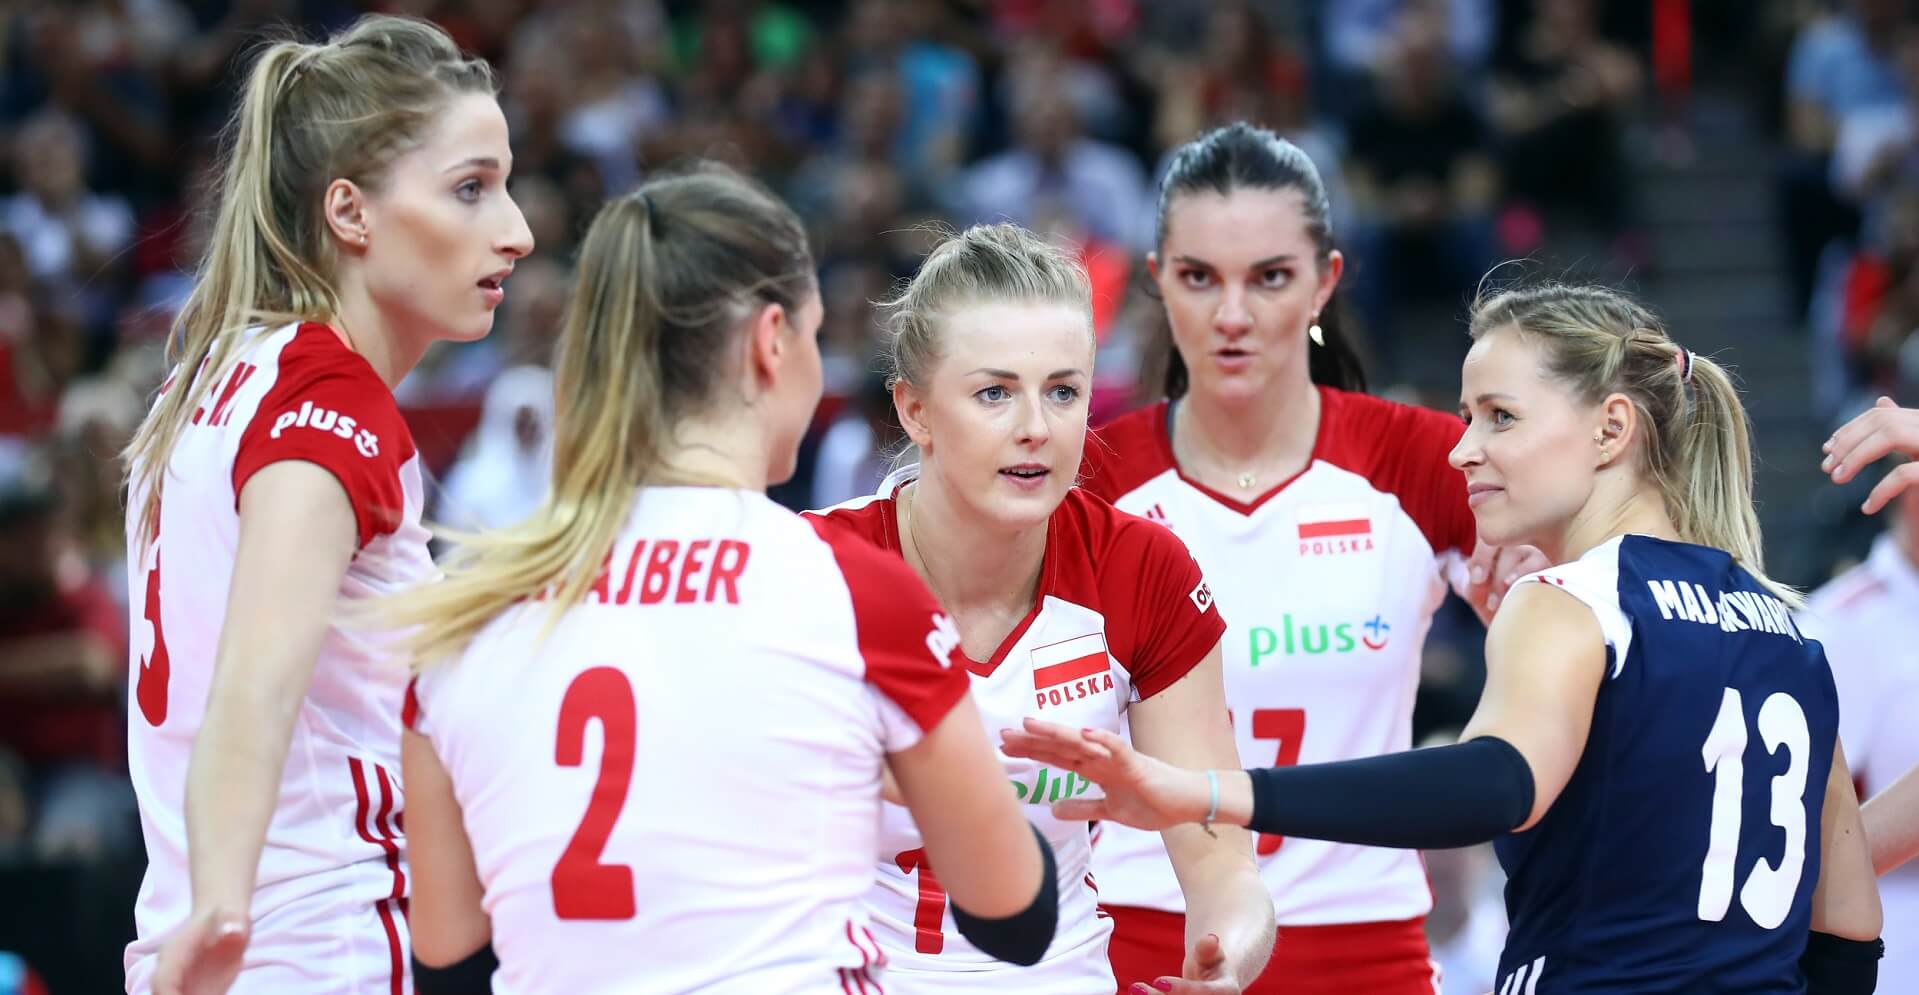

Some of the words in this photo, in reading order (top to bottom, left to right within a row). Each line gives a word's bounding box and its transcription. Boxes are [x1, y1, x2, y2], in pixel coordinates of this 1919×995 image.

[270, 401, 356, 439] plus
[512, 538, 751, 606] AJBER
[1299, 538, 1374, 556] POLSKA
[1249, 613, 1355, 667] plus
[1036, 673, 1114, 710] POLSKA
[550, 666, 637, 920] 2
[1228, 708, 1306, 858] 7
[1697, 686, 1811, 930] 13
[895, 846, 946, 955] 1
